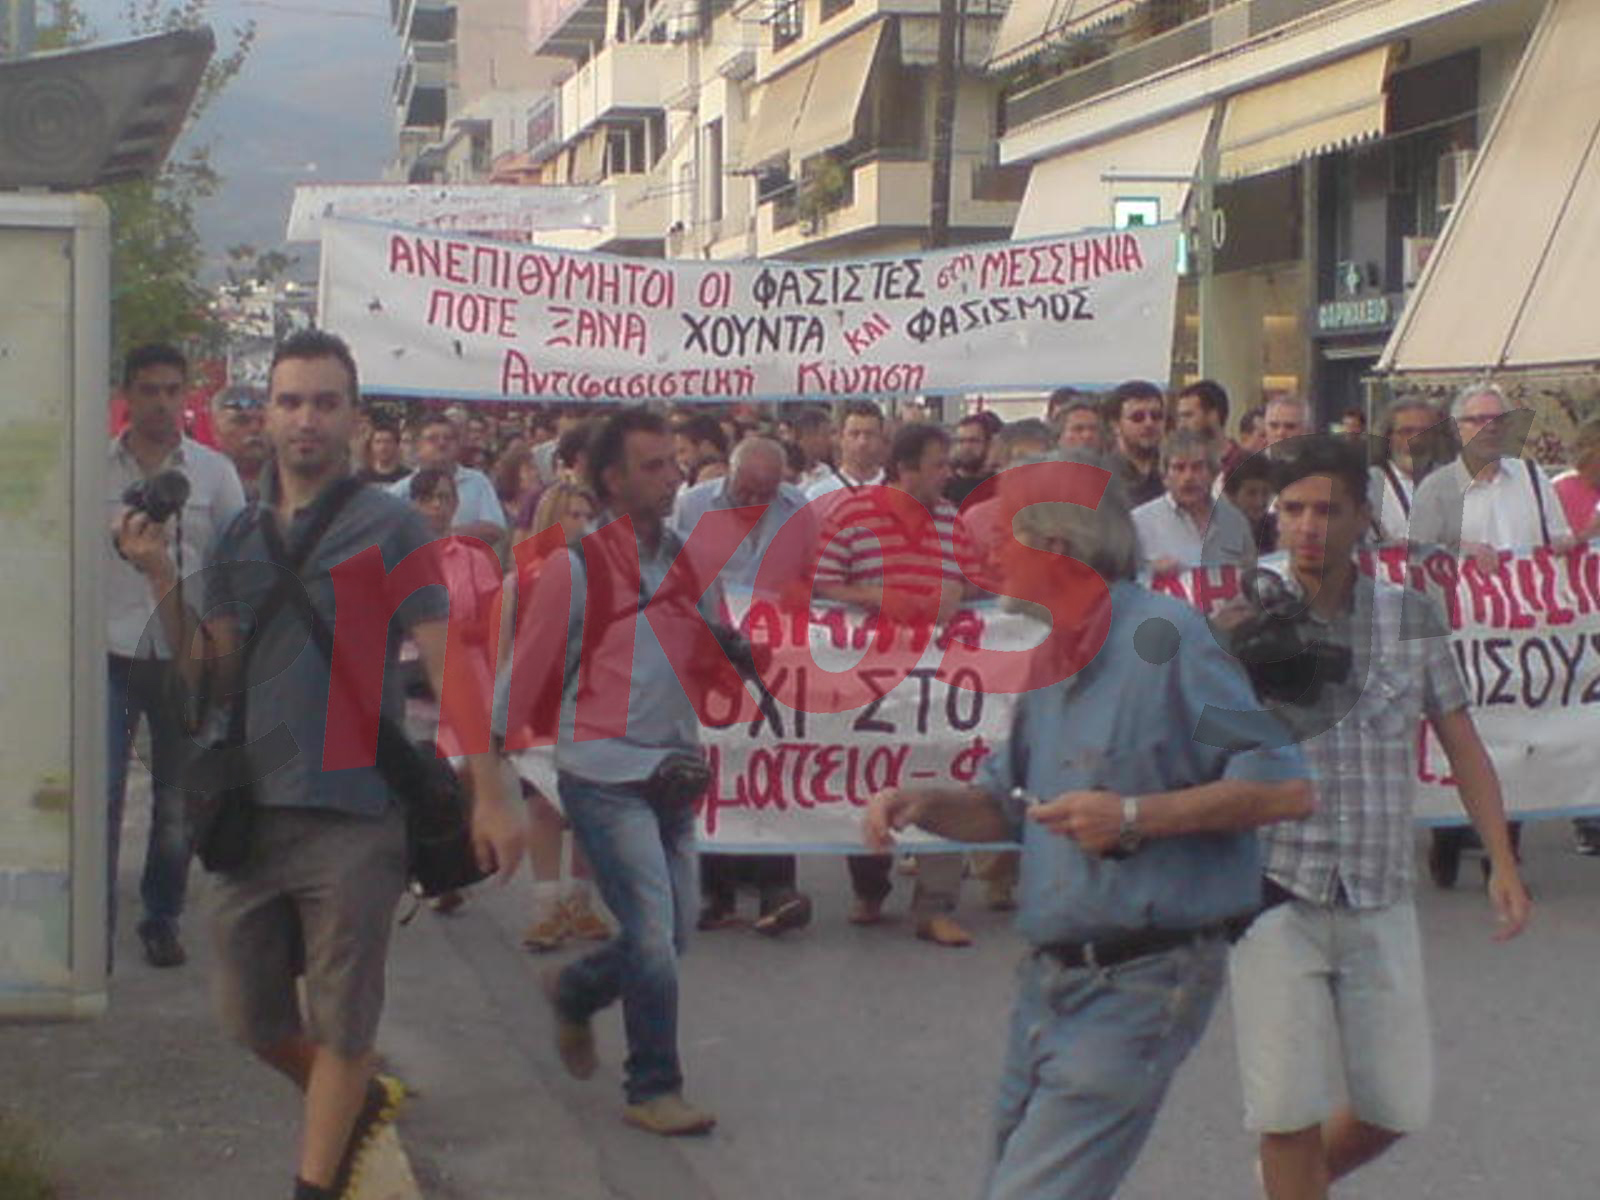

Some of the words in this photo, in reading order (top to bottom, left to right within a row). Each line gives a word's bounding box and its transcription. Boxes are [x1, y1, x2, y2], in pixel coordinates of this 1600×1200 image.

[389, 235, 674, 308] ΑΝΕΠΙΘΥΜΗΤΟΙ
[699, 272, 731, 307] ΟΙ
[752, 257, 926, 312] ΦΑΣΙΣΤΕΣ
[980, 234, 1143, 290] ΜΕΣΣΗΝΙΑ
[428, 291, 518, 337] ΠΟΤΕ
[545, 306, 646, 356] ΞΑΝΑ
[681, 312, 825, 358] ΧΟΥΝΤΑ
[842, 313, 892, 356] ΚΑΙ
[906, 286, 1096, 343] ΦΑΣΙΣΜΟΣ
[852, 664, 984, 734] ΣΤΟ
